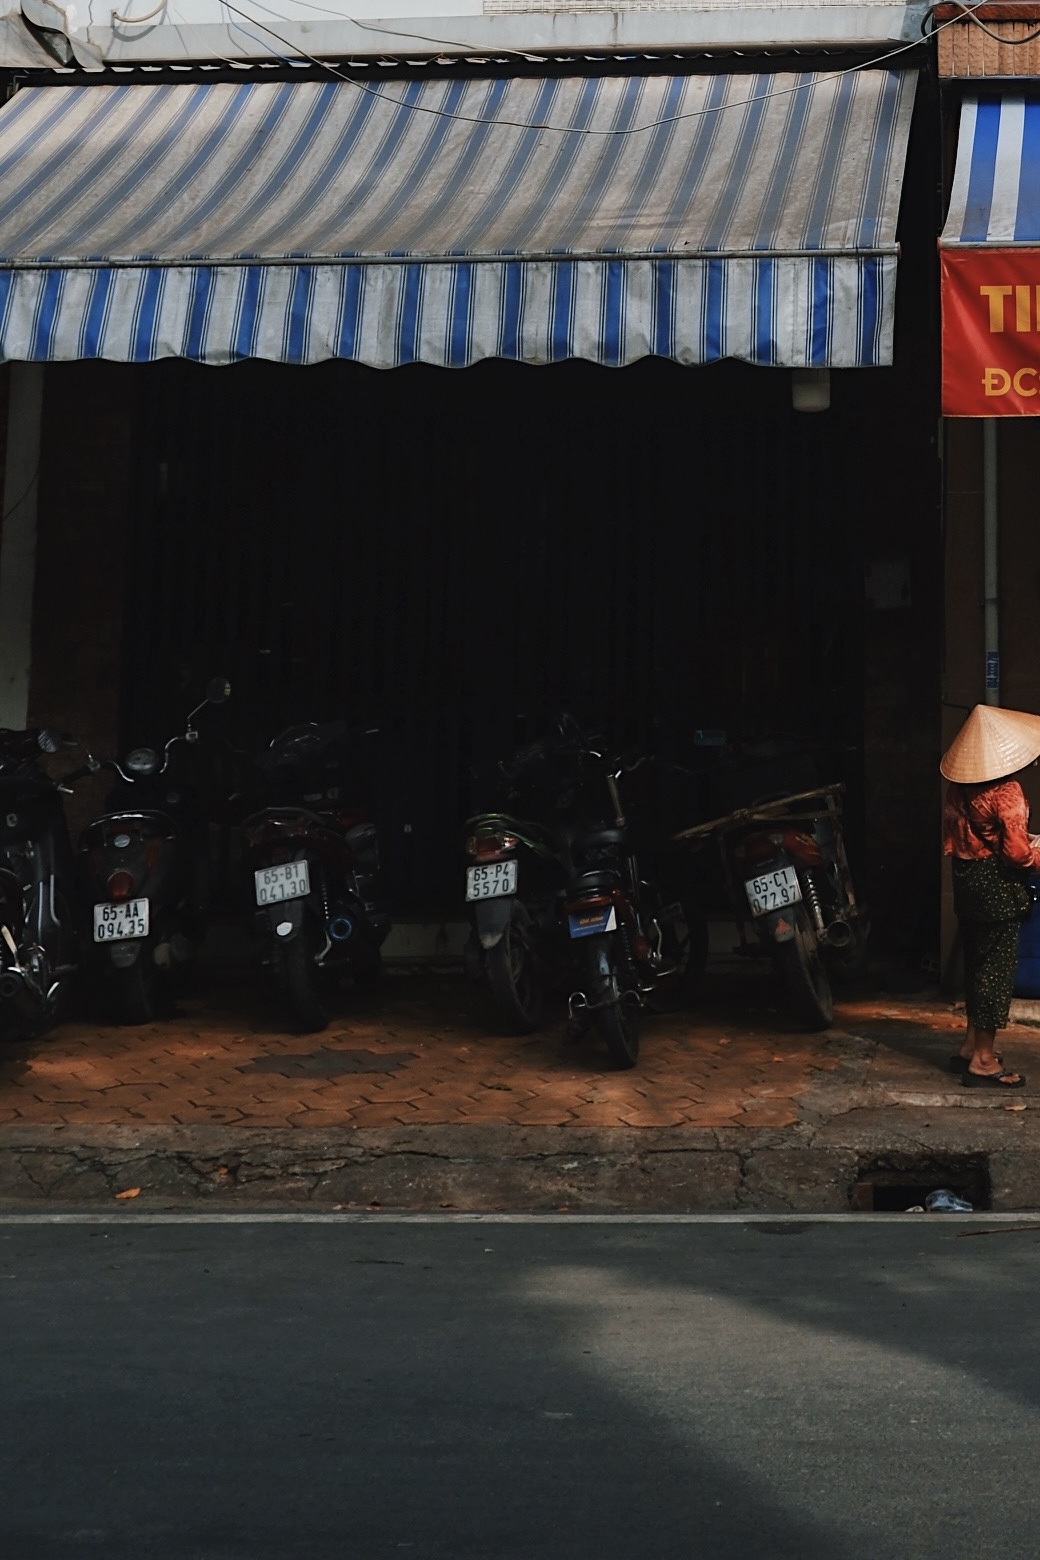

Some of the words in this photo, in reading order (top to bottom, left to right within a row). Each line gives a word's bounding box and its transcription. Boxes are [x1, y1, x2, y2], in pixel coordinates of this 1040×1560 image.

[473, 863, 510, 882] 65-P4
[473, 878, 510, 898] 5570
[102, 903, 139, 922] 65-AA
[97, 918, 145, 939] 094.35
